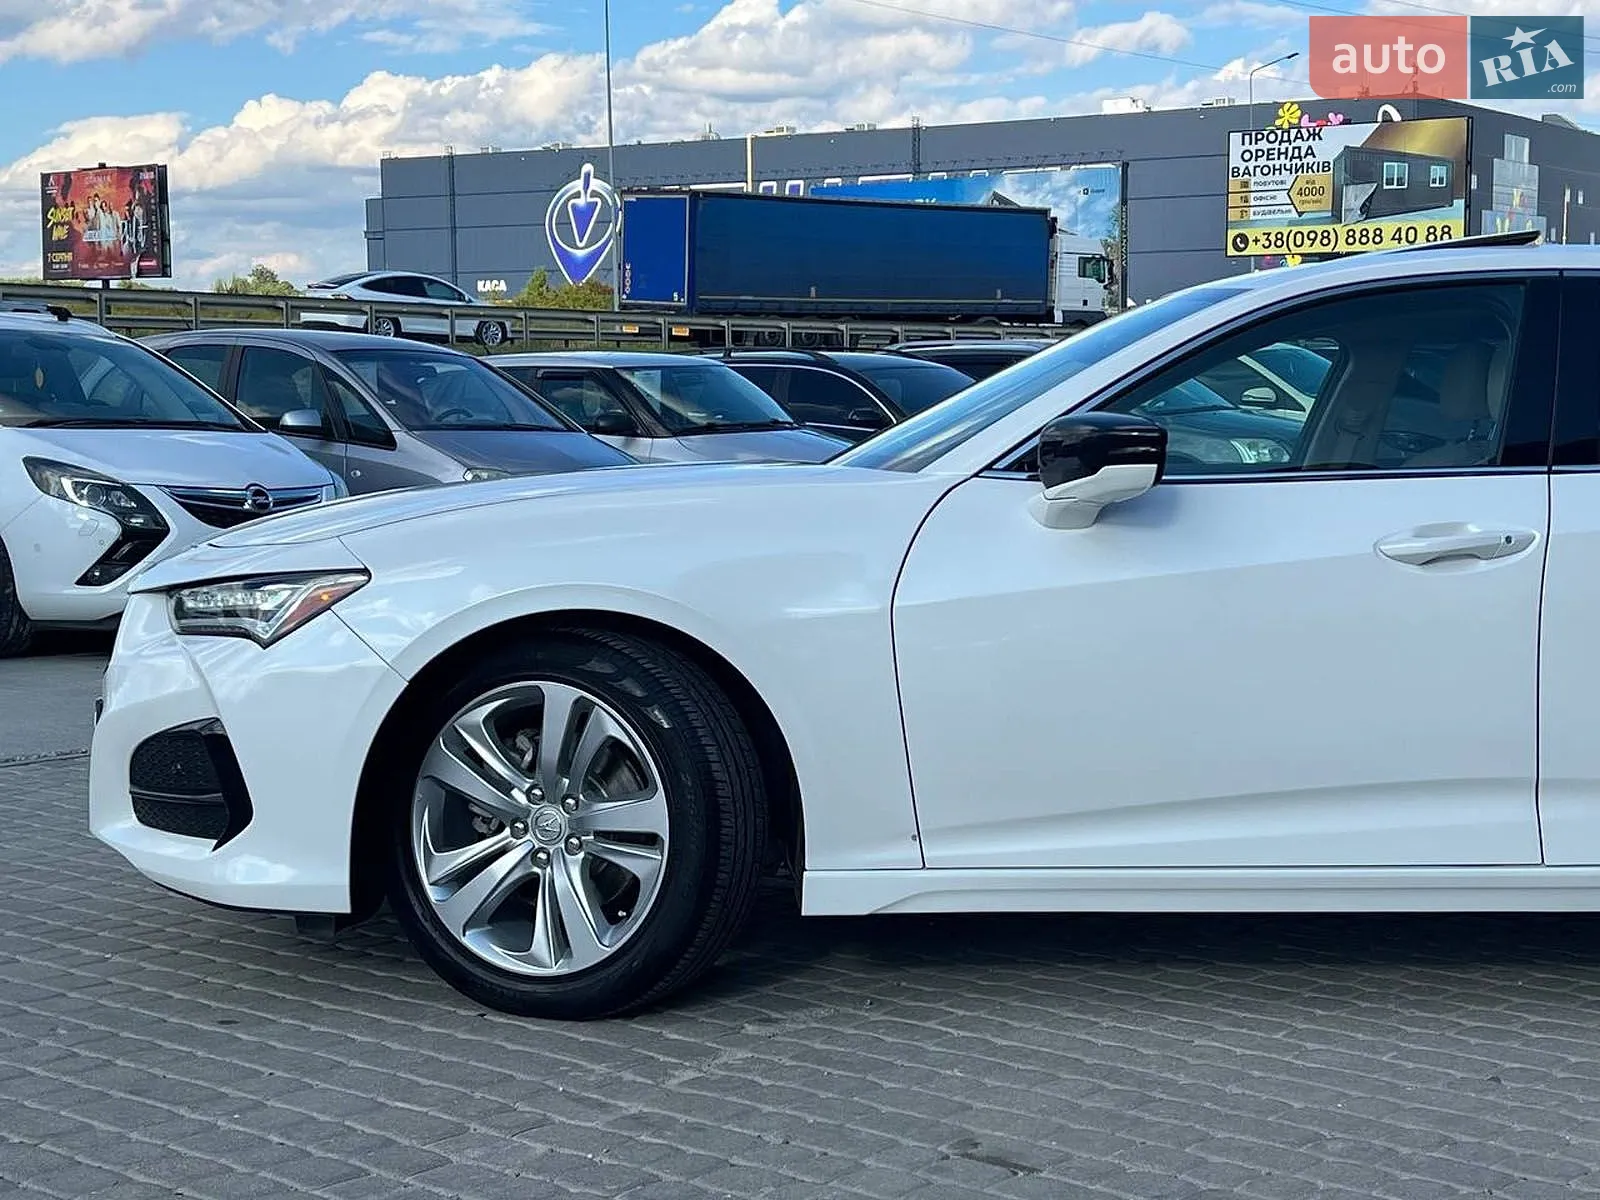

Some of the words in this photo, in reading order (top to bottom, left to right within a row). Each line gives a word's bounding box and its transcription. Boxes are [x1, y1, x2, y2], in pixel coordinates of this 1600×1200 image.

[1241, 128, 1323, 146] ПРОДАЖ
[1240, 145, 1317, 162] ОРЕНДА
[1231, 161, 1331, 178] ВАГОНЧИКІВ
[1297, 186, 1325, 197] 4000
[1252, 228, 1339, 252] +38(098)
[1345, 228, 1384, 246] 888
[1391, 226, 1418, 245] 40
[1425, 225, 1453, 242] 88
[477, 279, 507, 292] КАСА
